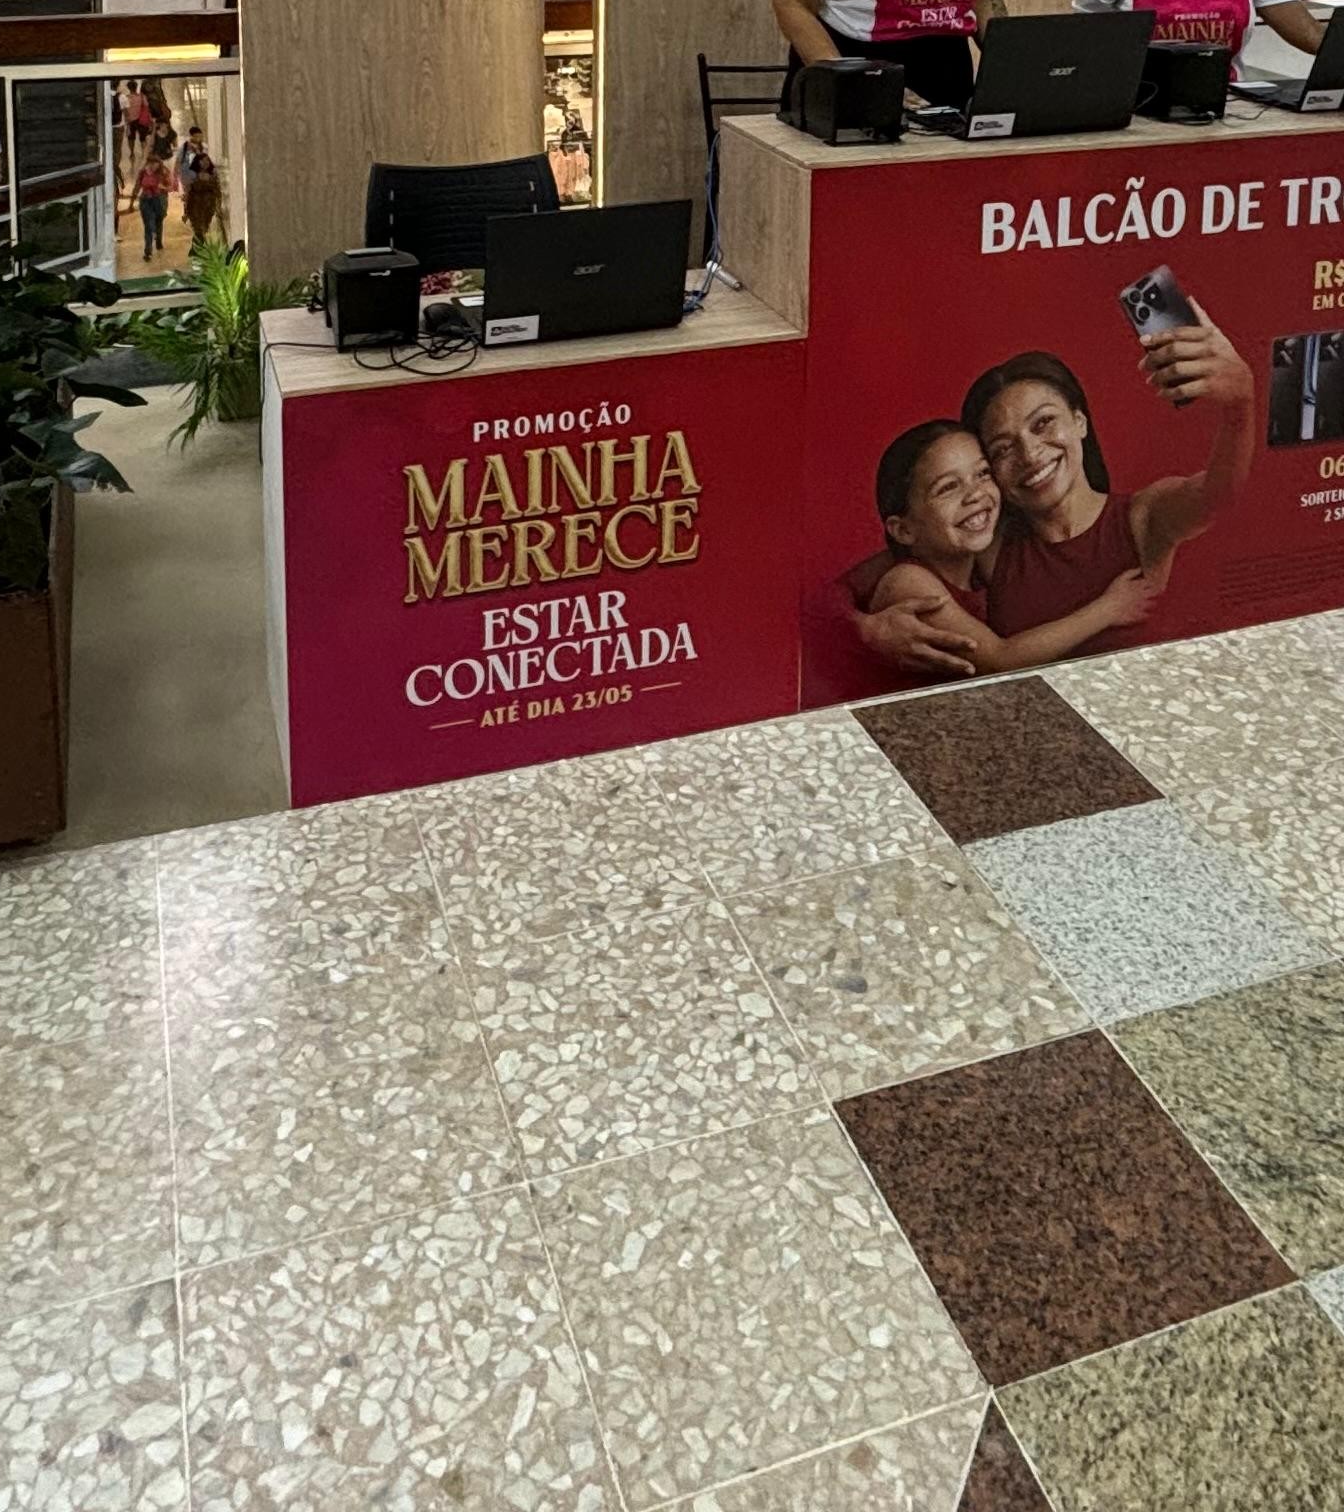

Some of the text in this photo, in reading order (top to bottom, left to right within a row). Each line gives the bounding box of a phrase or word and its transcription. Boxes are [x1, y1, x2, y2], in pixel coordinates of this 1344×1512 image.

[980, 176, 1187, 255] BALCÃO
[1201, 181, 1265, 236] DE
[1312, 294, 1335, 310] EM
[473, 402, 633, 442] PROMOÇÃO
[402, 430, 703, 534] MAINHA
[1323, 509, 1333, 524] 2
[402, 498, 701, 604] MERECE
[481, 590, 629, 651] ESTAR
[405, 623, 698, 707] CONECTADA
[480, 684, 633, 728] ATÉ DIA 23/05
